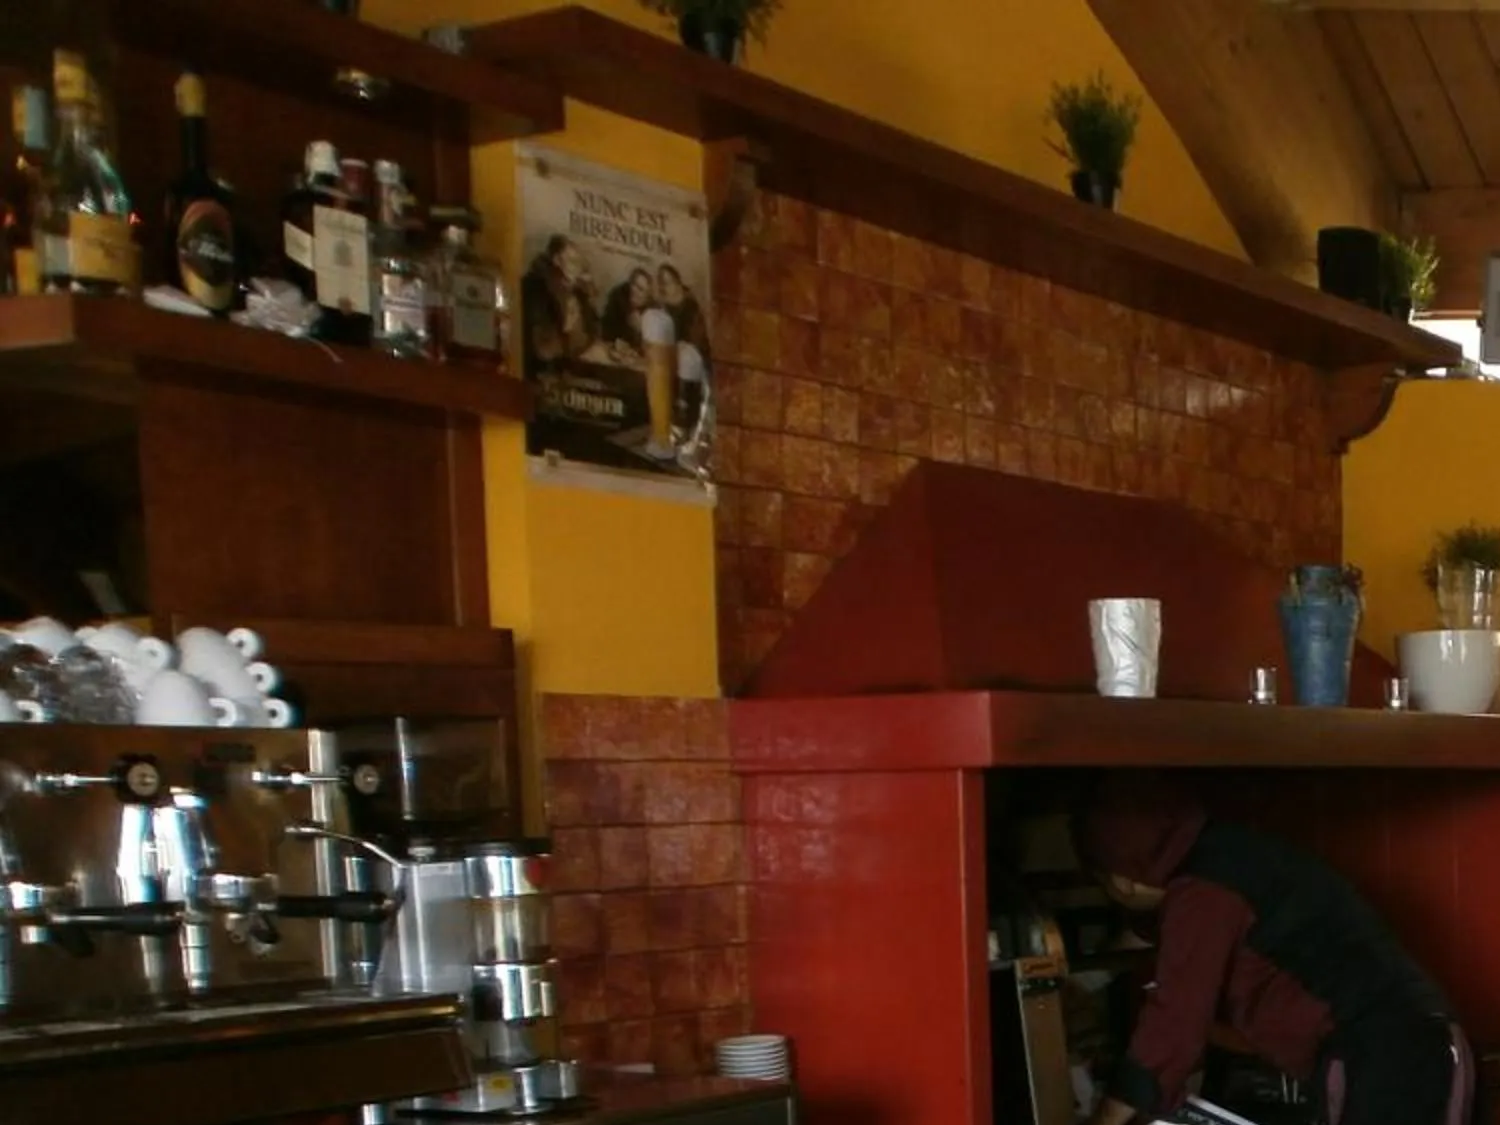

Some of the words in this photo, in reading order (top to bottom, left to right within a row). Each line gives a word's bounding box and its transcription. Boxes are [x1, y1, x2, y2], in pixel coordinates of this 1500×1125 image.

[573, 189, 629, 220] NUNC
[635, 207, 669, 231] EST
[569, 209, 673, 256] BIBENDUM
